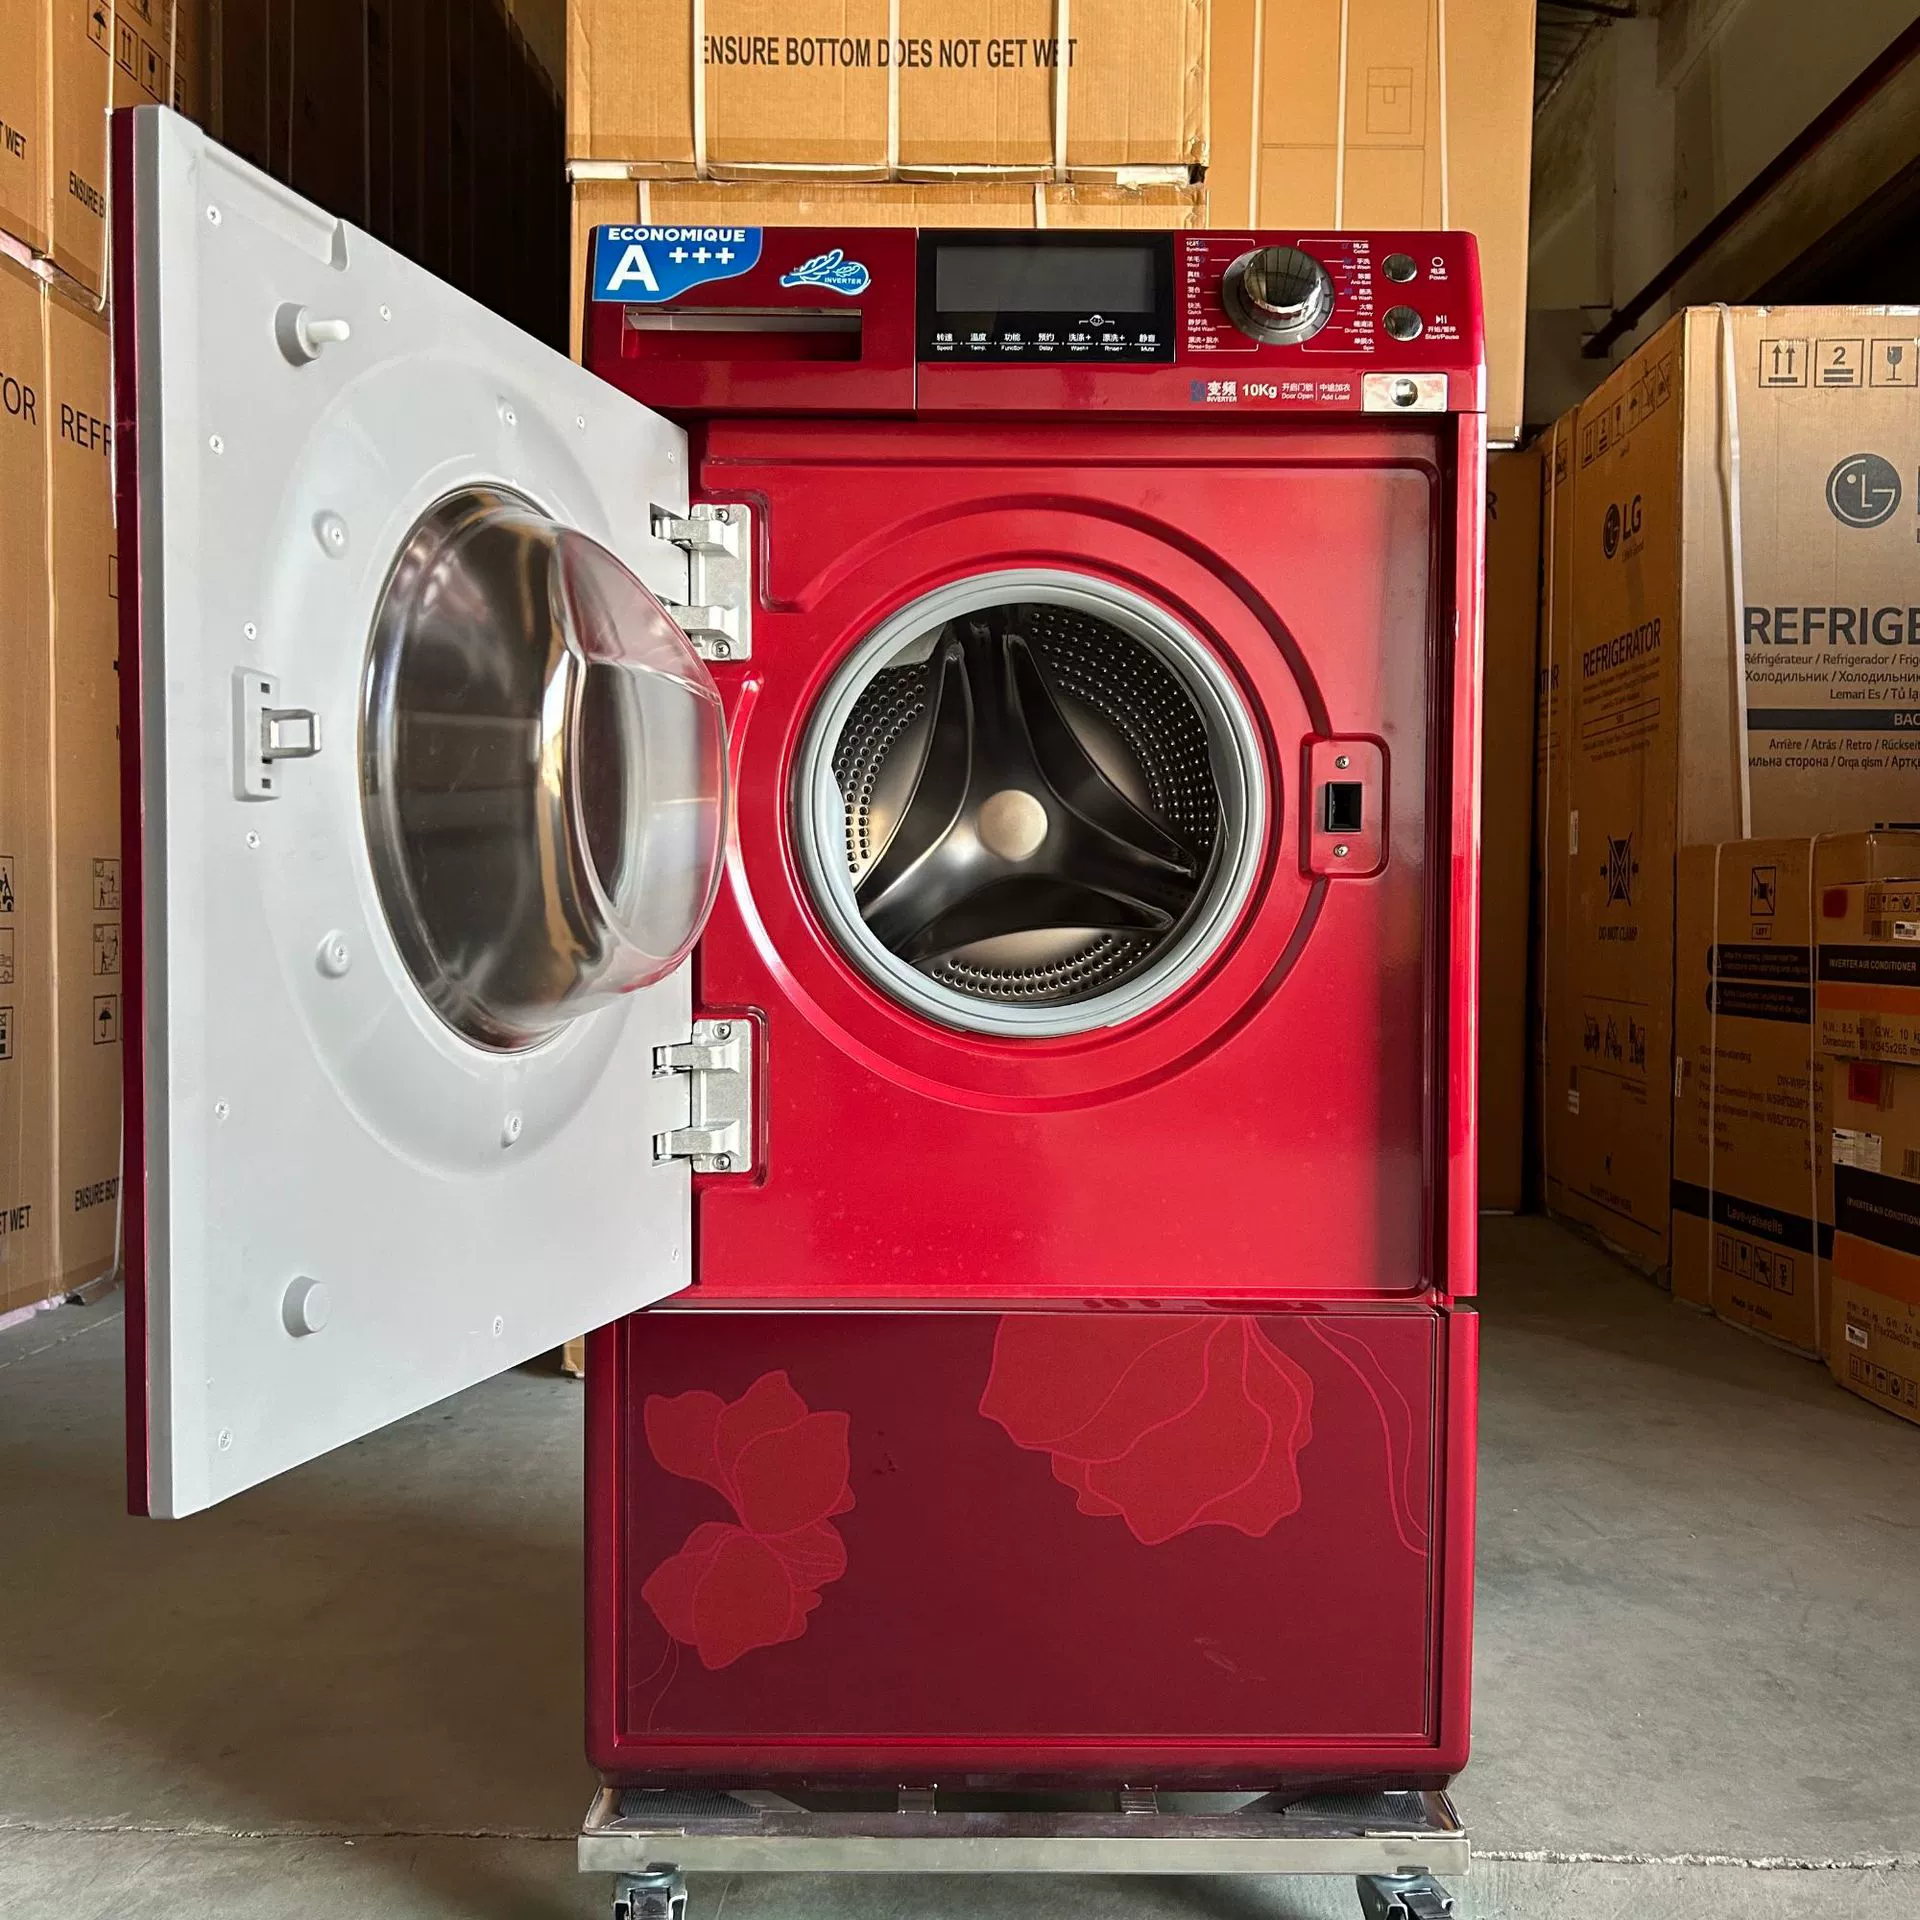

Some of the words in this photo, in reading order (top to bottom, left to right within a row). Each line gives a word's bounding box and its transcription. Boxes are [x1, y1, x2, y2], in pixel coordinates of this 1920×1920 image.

[786, 37, 871, 67] BOTTOM
[877, 38, 932, 67] DOES
[940, 39, 981, 67] NOT
[987, 39, 1027, 67] GET
[5, 124, 27, 160] WET
[69, 170, 98, 214] ENSURE
[607, 227, 746, 242] ECONOMIQUE
[606, 244, 660, 291] A
[824, 277, 862, 285] INVERTER
[1833, 346, 1847, 365] 2
[1207, 381, 1237, 397] 变频
[1242, 383, 1278, 399] 10Kg
[1281, 392, 1296, 400] Door
[1296, 393, 1314, 401] Open
[1334, 393, 1350, 401] Load
[0, 371, 36, 426] OR
[1622, 493, 1642, 541] LG
[1582, 617, 1661, 680] REFRIGERATOR
[1744, 653, 1813, 668] Réfrigérateur
[1823, 653, 1889, 668] Refrigerador
[1745, 670, 1828, 684] Холодильник
[1829, 688, 1865, 700] Lemari
[1868, 688, 1880, 700] Es
[1768, 738, 1802, 751] Arrière
[1811, 738, 1837, 751] Atrás
[1846, 739, 1872, 751] Retro
[1785, 757, 1829, 771] сторона
[1837, 756, 1860, 771] Orqa
[1861, 756, 1883, 772] qism
[1829, 958, 1857, 969] INVERTER
[1858, 959, 1870, 969] AIR
[1870, 960, 1917, 972] CONDITIONER
[75, 1182, 104, 1213] ENSURE
[9, 1204, 31, 1233] WET
